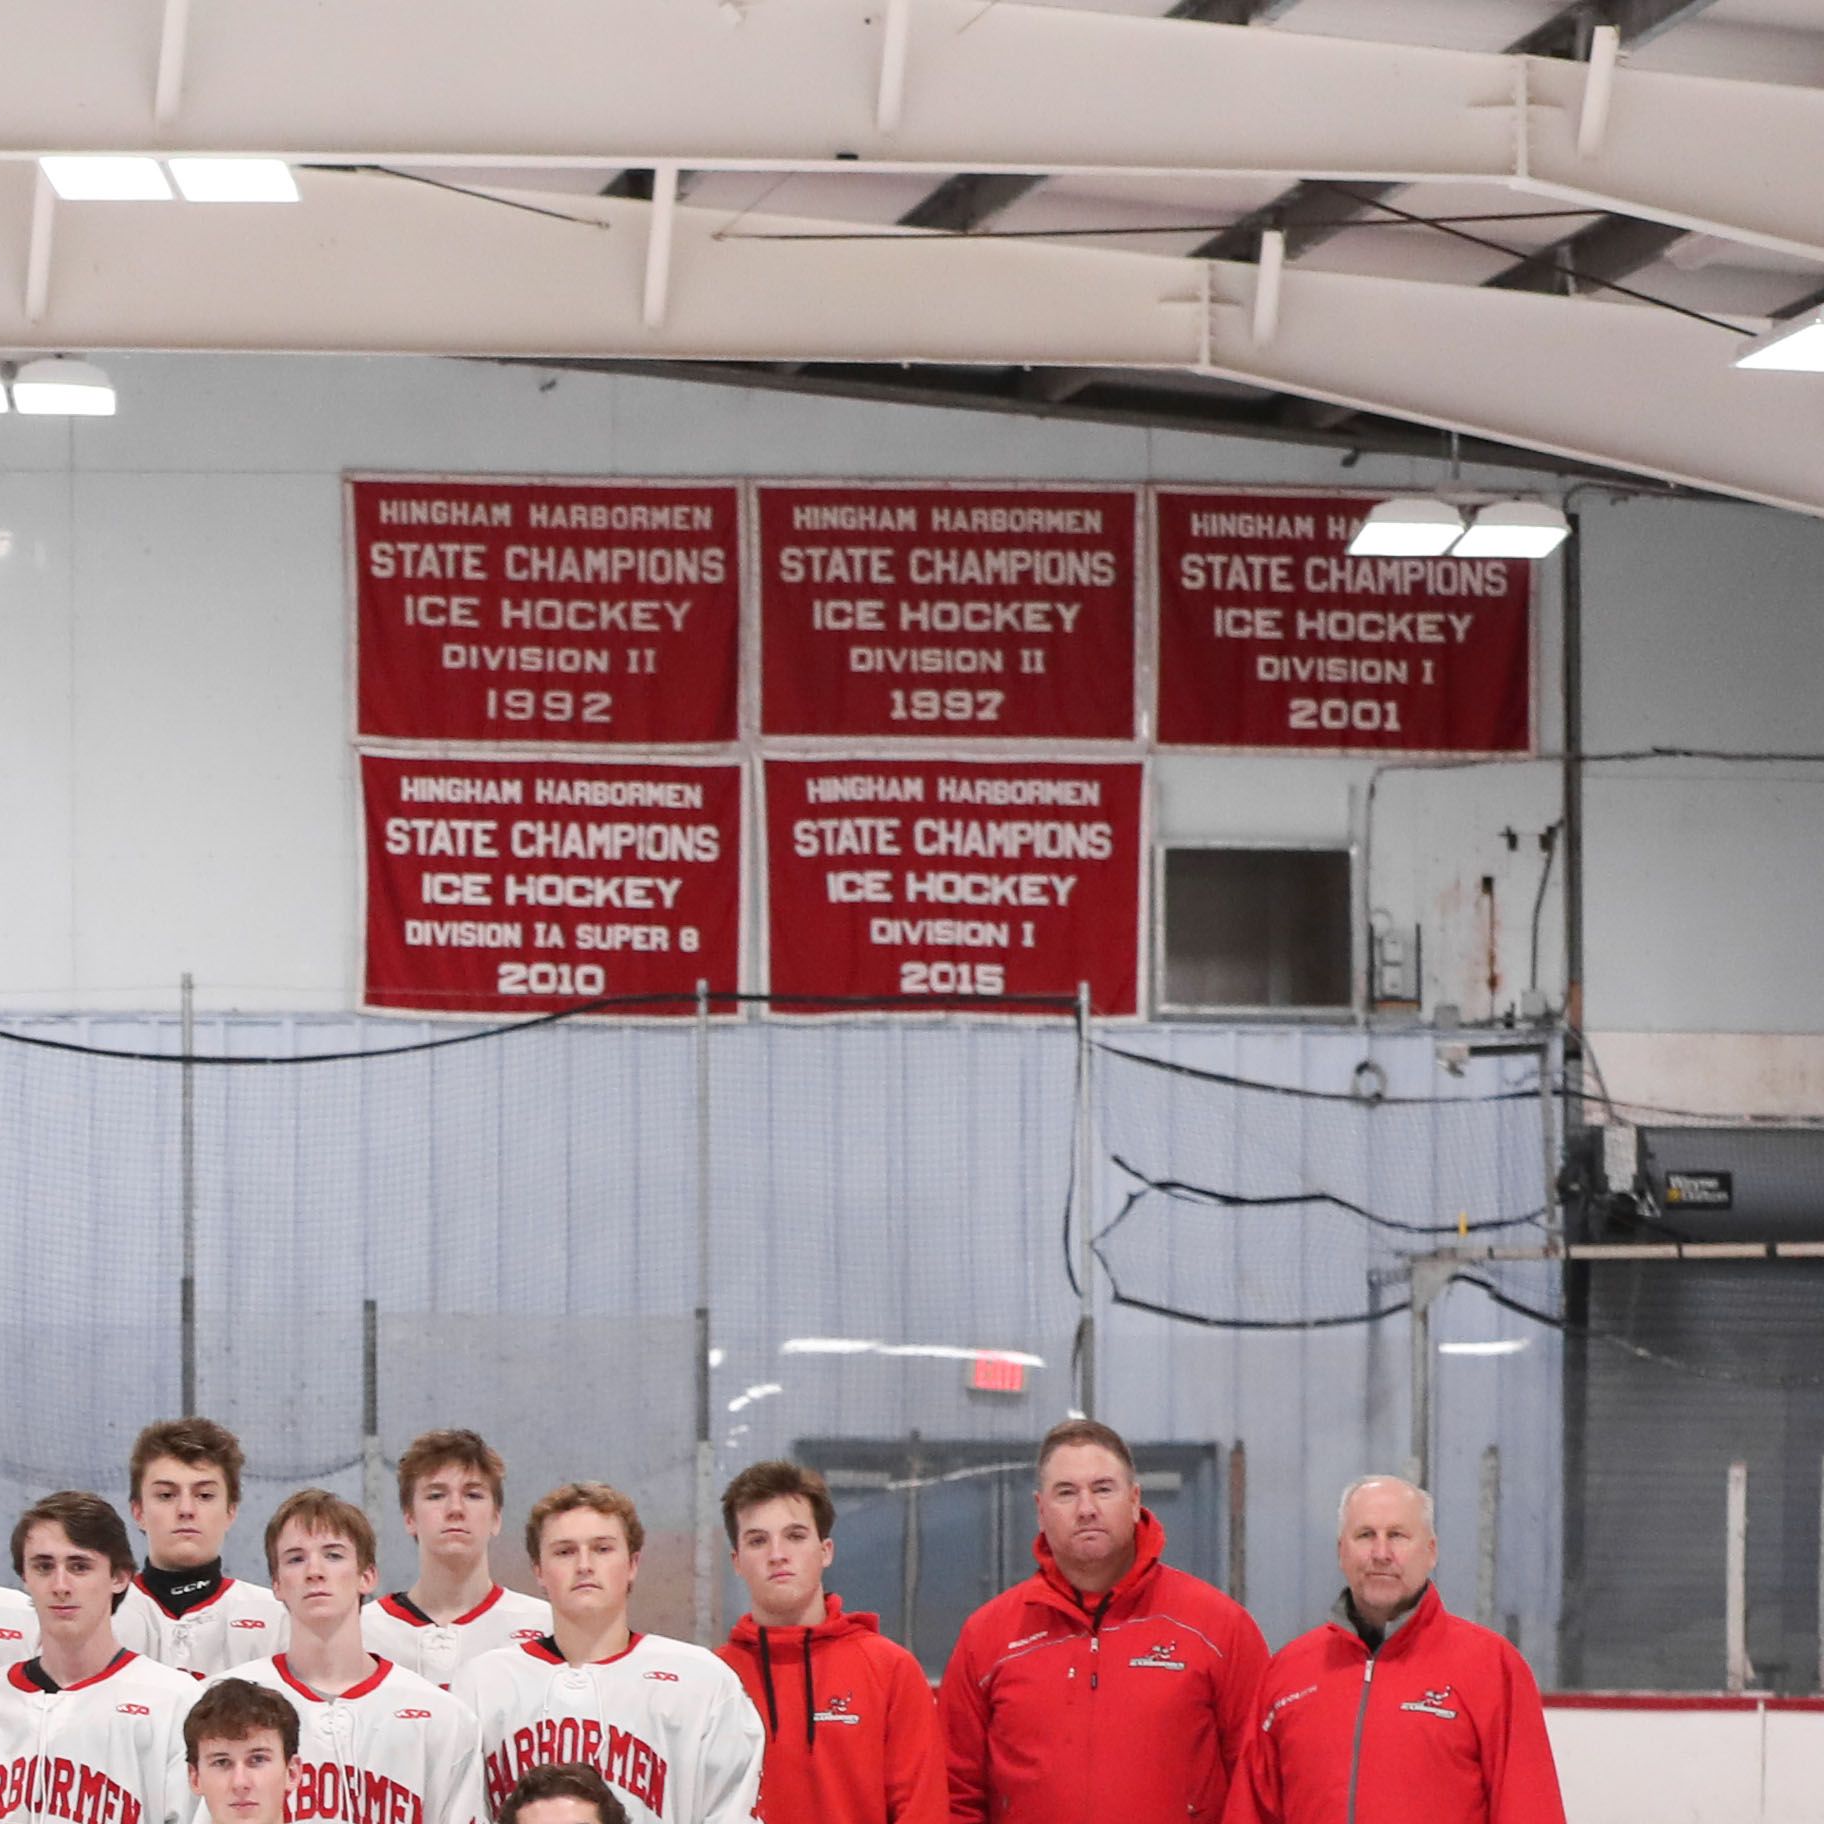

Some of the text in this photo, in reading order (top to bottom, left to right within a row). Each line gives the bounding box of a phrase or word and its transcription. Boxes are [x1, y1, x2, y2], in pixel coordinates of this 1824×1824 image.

[380, 500, 712, 530] HINGHAM HARBORMEN
[793, 506, 1102, 533] HINGHAM HARBORMEN
[1191, 513, 1314, 538] HINGHAM
[371, 542, 724, 584] STATE CHAMPIONS
[780, 547, 1115, 586] STATE CHAMPIONS
[1182, 554, 1506, 596] STATE CHAMPIONS
[405, 595, 690, 631] ICE HOCKEY
[813, 600, 1080, 632] ICE HOCKEY
[1214, 608, 1472, 642] ICE HOCKEY
[443, 644, 656, 673] DIVISION II
[850, 647, 1045, 673] DIVISION II
[1257, 655, 1433, 684] DIVISION I
[487, 689, 612, 722] 1992
[891, 690, 1004, 720] 1997
[1289, 699, 1400, 731] 2001
[401, 776, 702, 808] HINGHAM HARBORMEN
[807, 776, 1100, 806] HINGHAM HARBORMEN
[386, 818, 719, 861] STATE CHAMPIONS
[794, 818, 1112, 859] STATE CHAMPIONS
[422, 873, 682, 908] ICE HOCKEY
[827, 871, 1076, 905] ICE HOCKEY
[405, 920, 699, 952] DIVISION IA SUPER 8
[870, 918, 1034, 947] DIVISION I
[498, 963, 604, 995] 2010
[901, 962, 1003, 995] 2015
